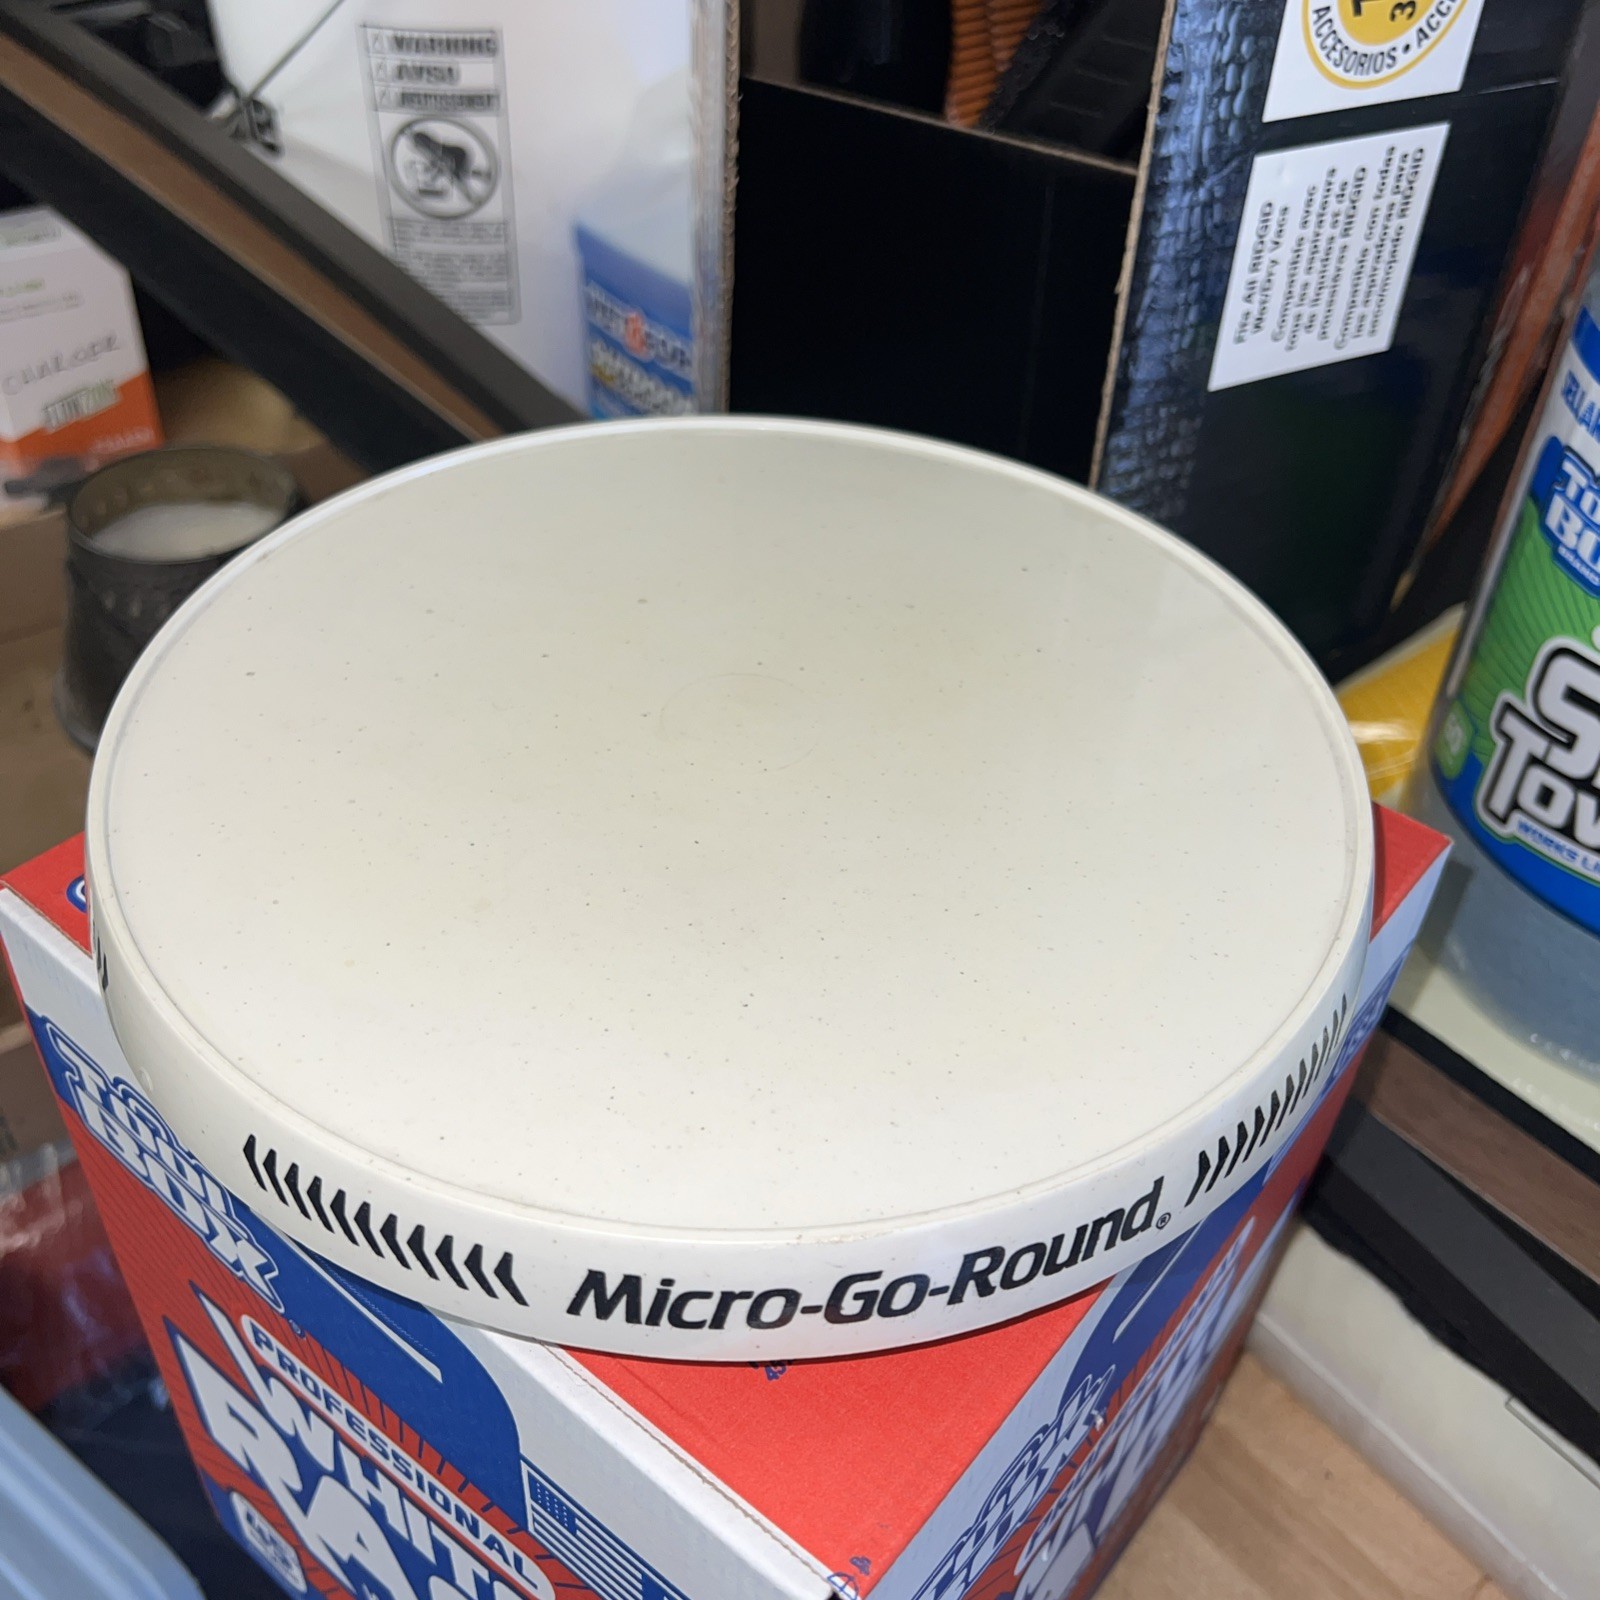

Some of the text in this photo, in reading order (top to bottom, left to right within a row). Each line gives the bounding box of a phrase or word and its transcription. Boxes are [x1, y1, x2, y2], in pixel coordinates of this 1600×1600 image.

[1312, 5, 1398, 76] ACCESORIOS
[1336, 180, 1349, 204] de
[1339, 166, 1367, 239] RIDGID
[1362, 201, 1395, 307] aspiradoras
[1391, 152, 1409, 197] para
[1397, 148, 1425, 220] RIDGID
[1249, 201, 1274, 275] RIDGID
[1252, 205, 1289, 335] Wet/Dry Vacs
[1270, 184, 1317, 343] Compatible avec
[1284, 312, 1302, 352] tous
[1304, 167, 1337, 275] aspirateurs
[1309, 235, 1336, 308] liquides
[1334, 145, 1395, 350] Compatible con todas
[1242, 279, 1257, 304] All
[1303, 312, 1317, 334] de
[53, 1032, 248, 1240] TOOL
[73, 1084, 279, 1301] BOX
[250, 1320, 539, 1590] PROFESSIONAL
